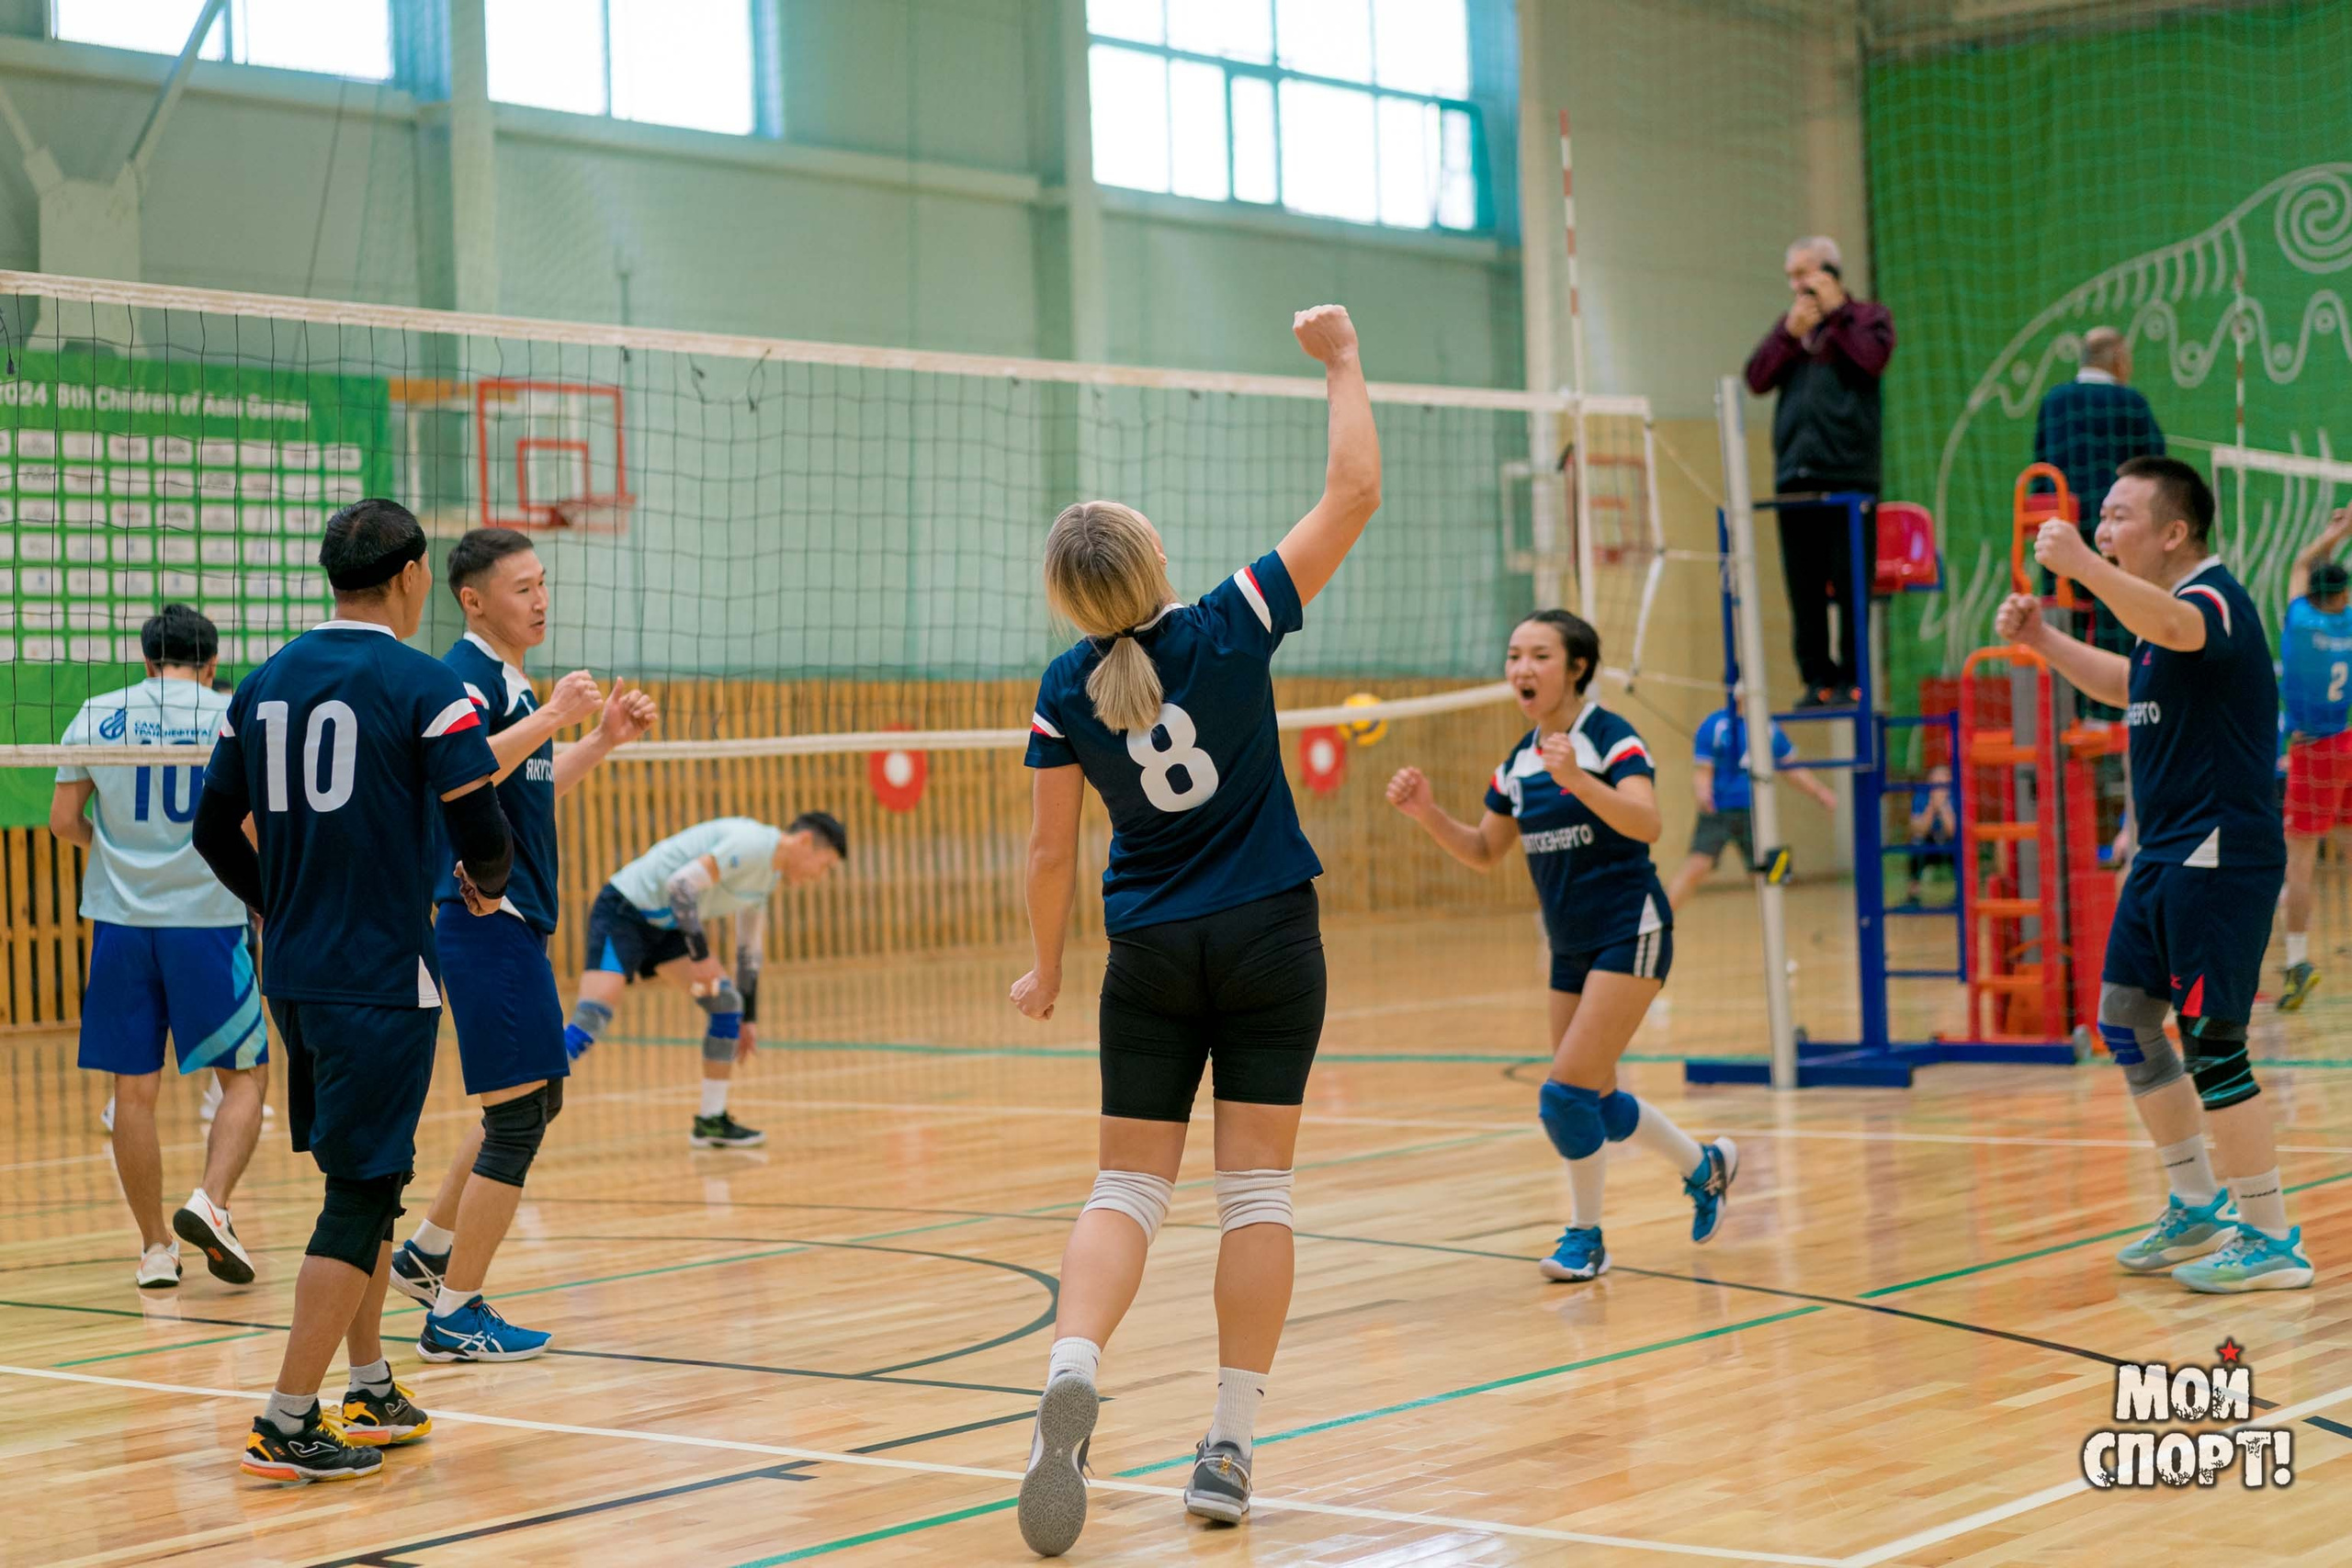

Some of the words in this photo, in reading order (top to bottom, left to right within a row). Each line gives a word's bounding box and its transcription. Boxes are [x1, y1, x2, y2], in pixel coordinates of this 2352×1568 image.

[0, 379, 49, 407] 024
[96, 384, 175, 416] Children
[179, 390, 199, 416] of
[2327, 661, 2349, 702] 2
[135, 739, 204, 823] 10
[255, 700, 358, 813] 10
[1126, 703, 1219, 813] 8
